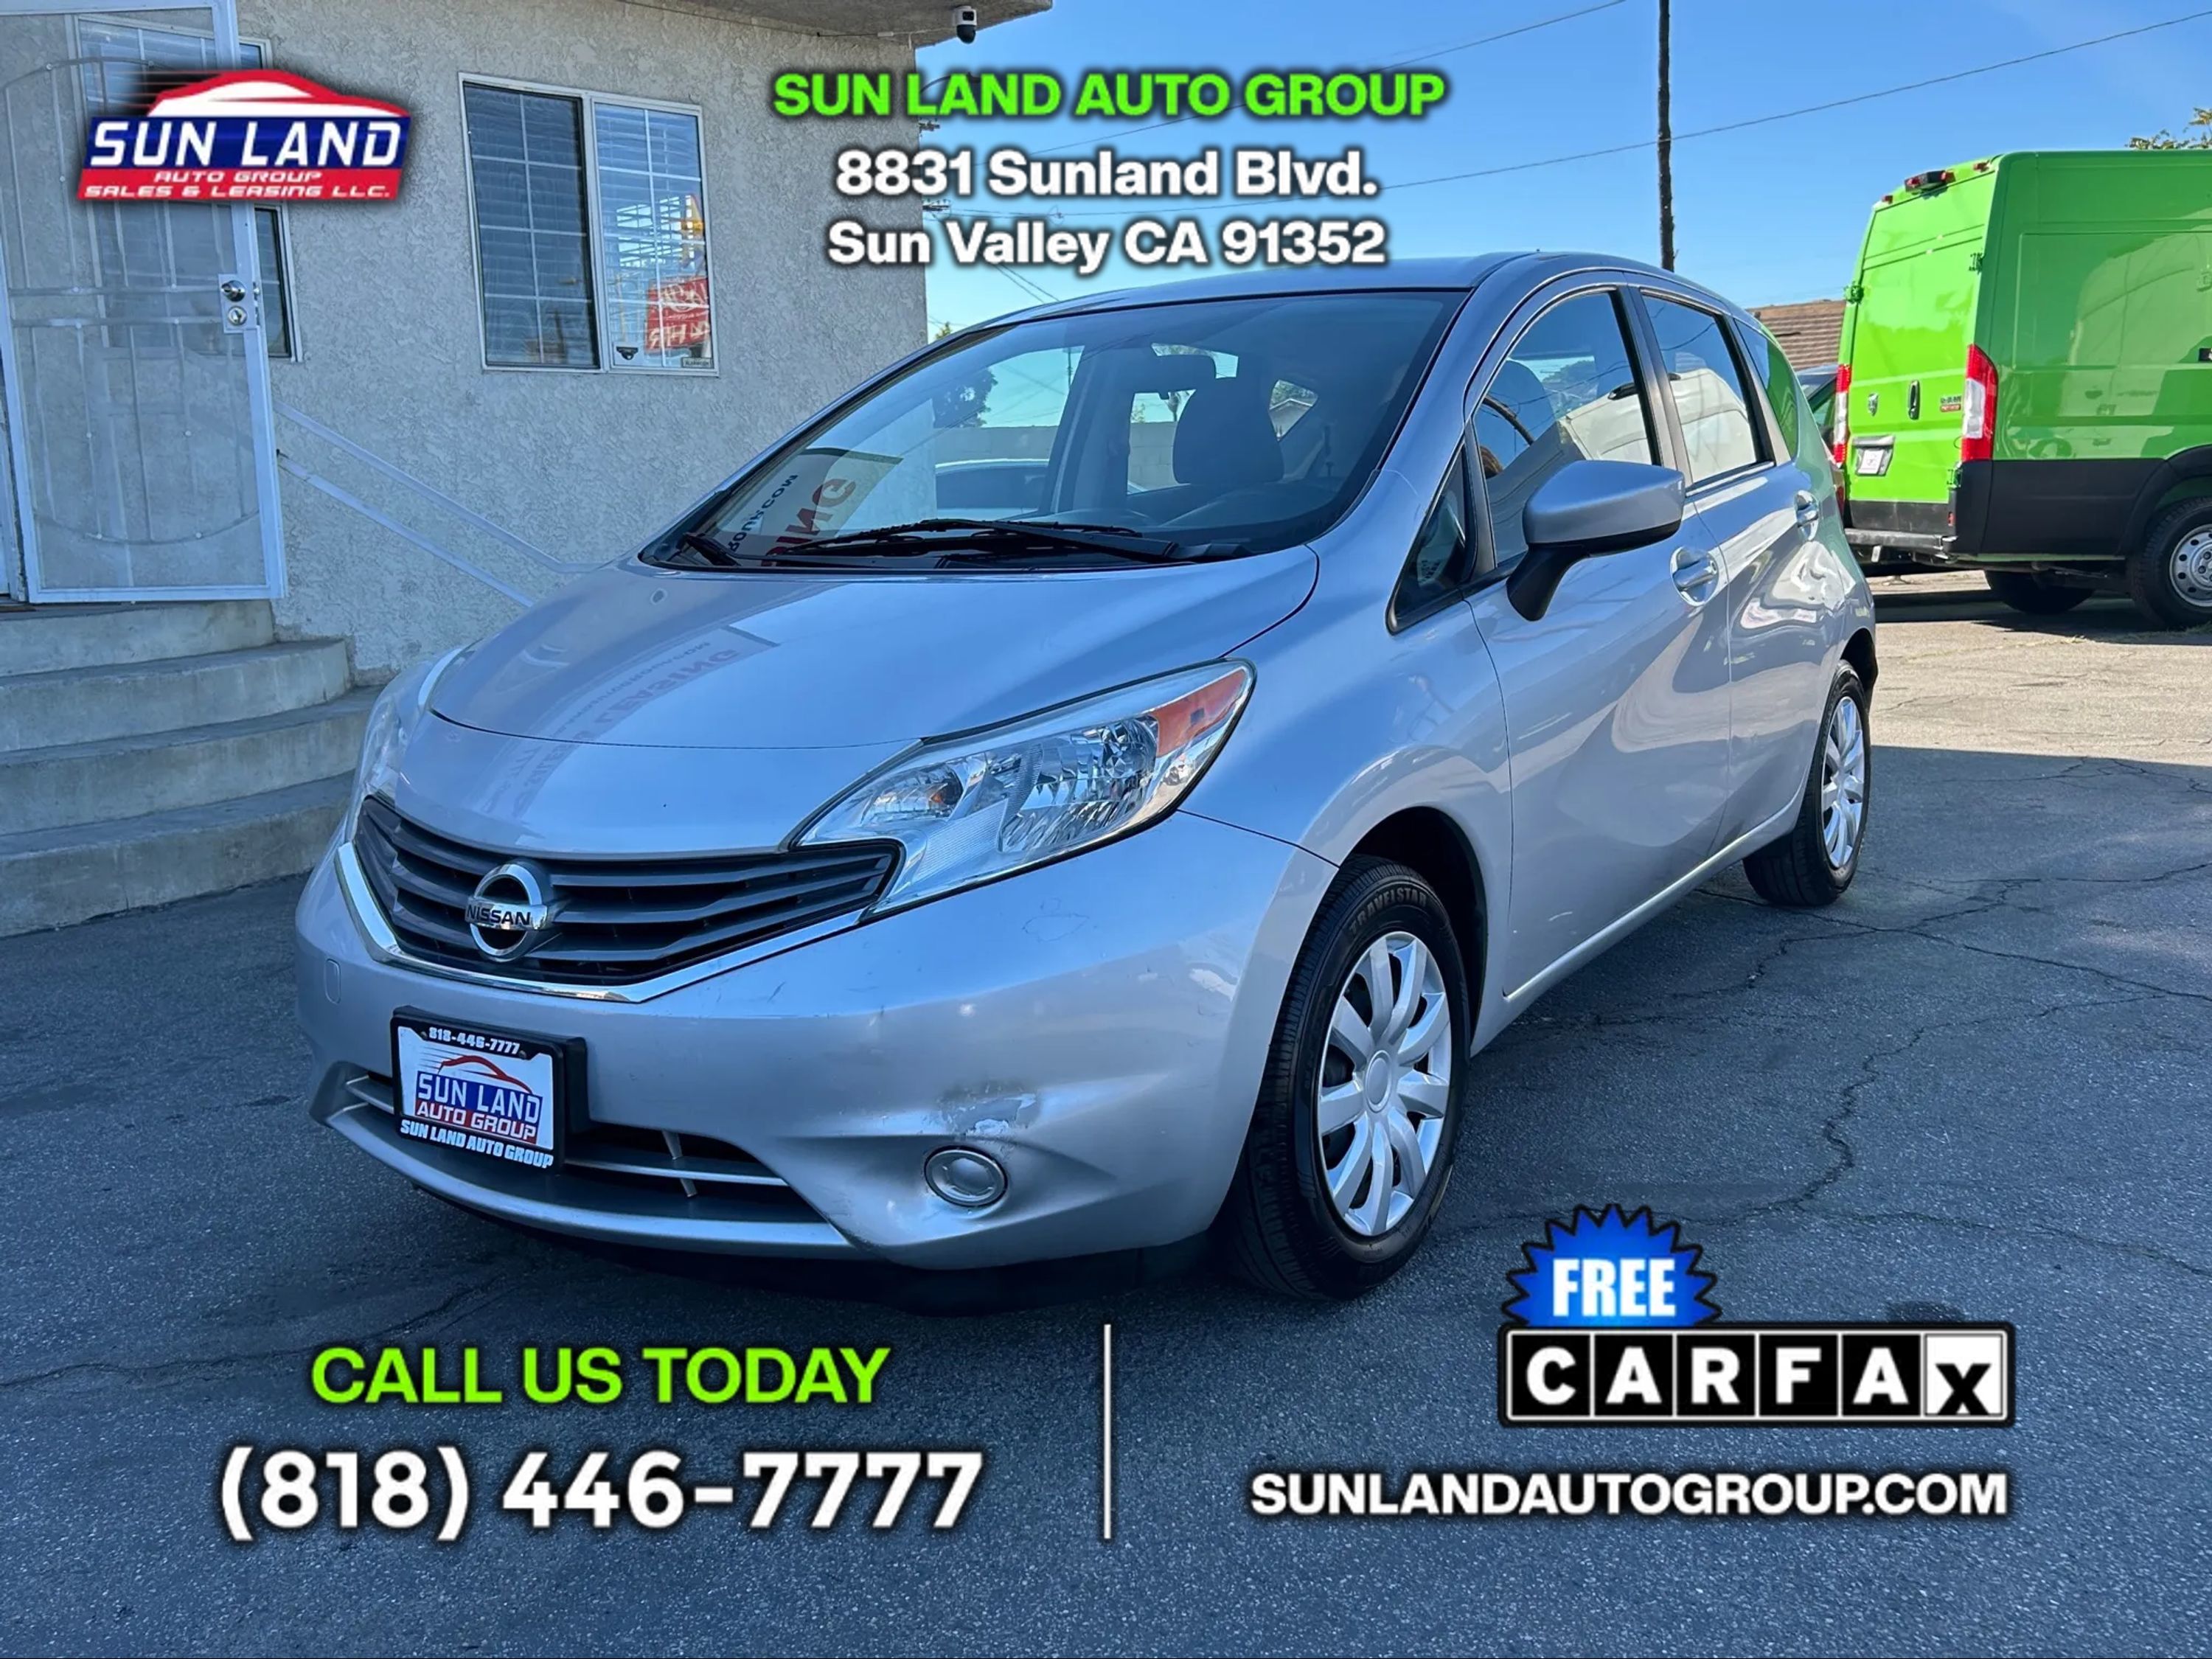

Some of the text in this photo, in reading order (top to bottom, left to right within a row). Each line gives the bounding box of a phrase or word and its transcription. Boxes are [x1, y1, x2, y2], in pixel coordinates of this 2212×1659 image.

[467, 905, 532, 925] NISSAN
[428, 1026, 521, 1054] 818-446-7777
[417, 1073, 540, 1124] SUN LAND
[417, 1101, 537, 1141] AUTO GROUP
[400, 1119, 554, 1169] SUN LAND AUTO GROUP
